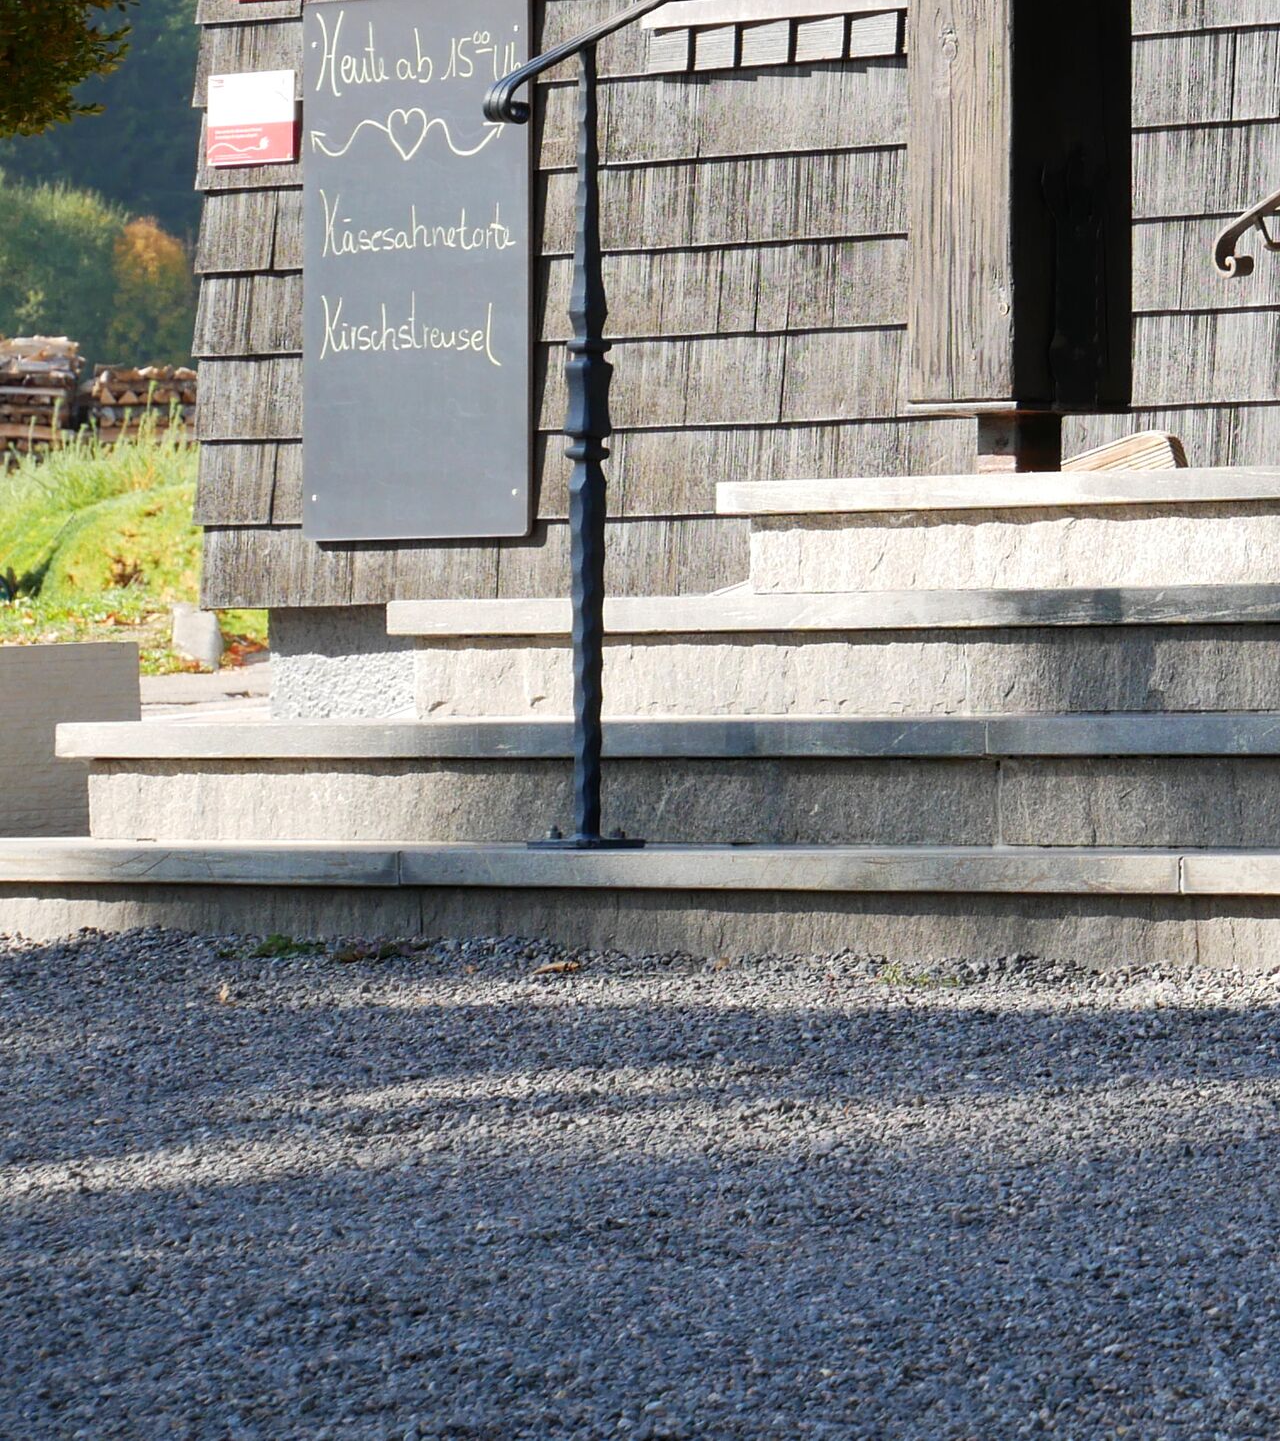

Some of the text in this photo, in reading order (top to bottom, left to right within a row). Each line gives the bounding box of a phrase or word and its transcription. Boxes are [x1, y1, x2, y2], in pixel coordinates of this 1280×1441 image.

[315, 10, 390, 97] Heute
[396, 28, 433, 83] ab
[320, 188, 516, 257] Käsesahnetorte
[320, 291, 502, 366] Kirschstreusel
